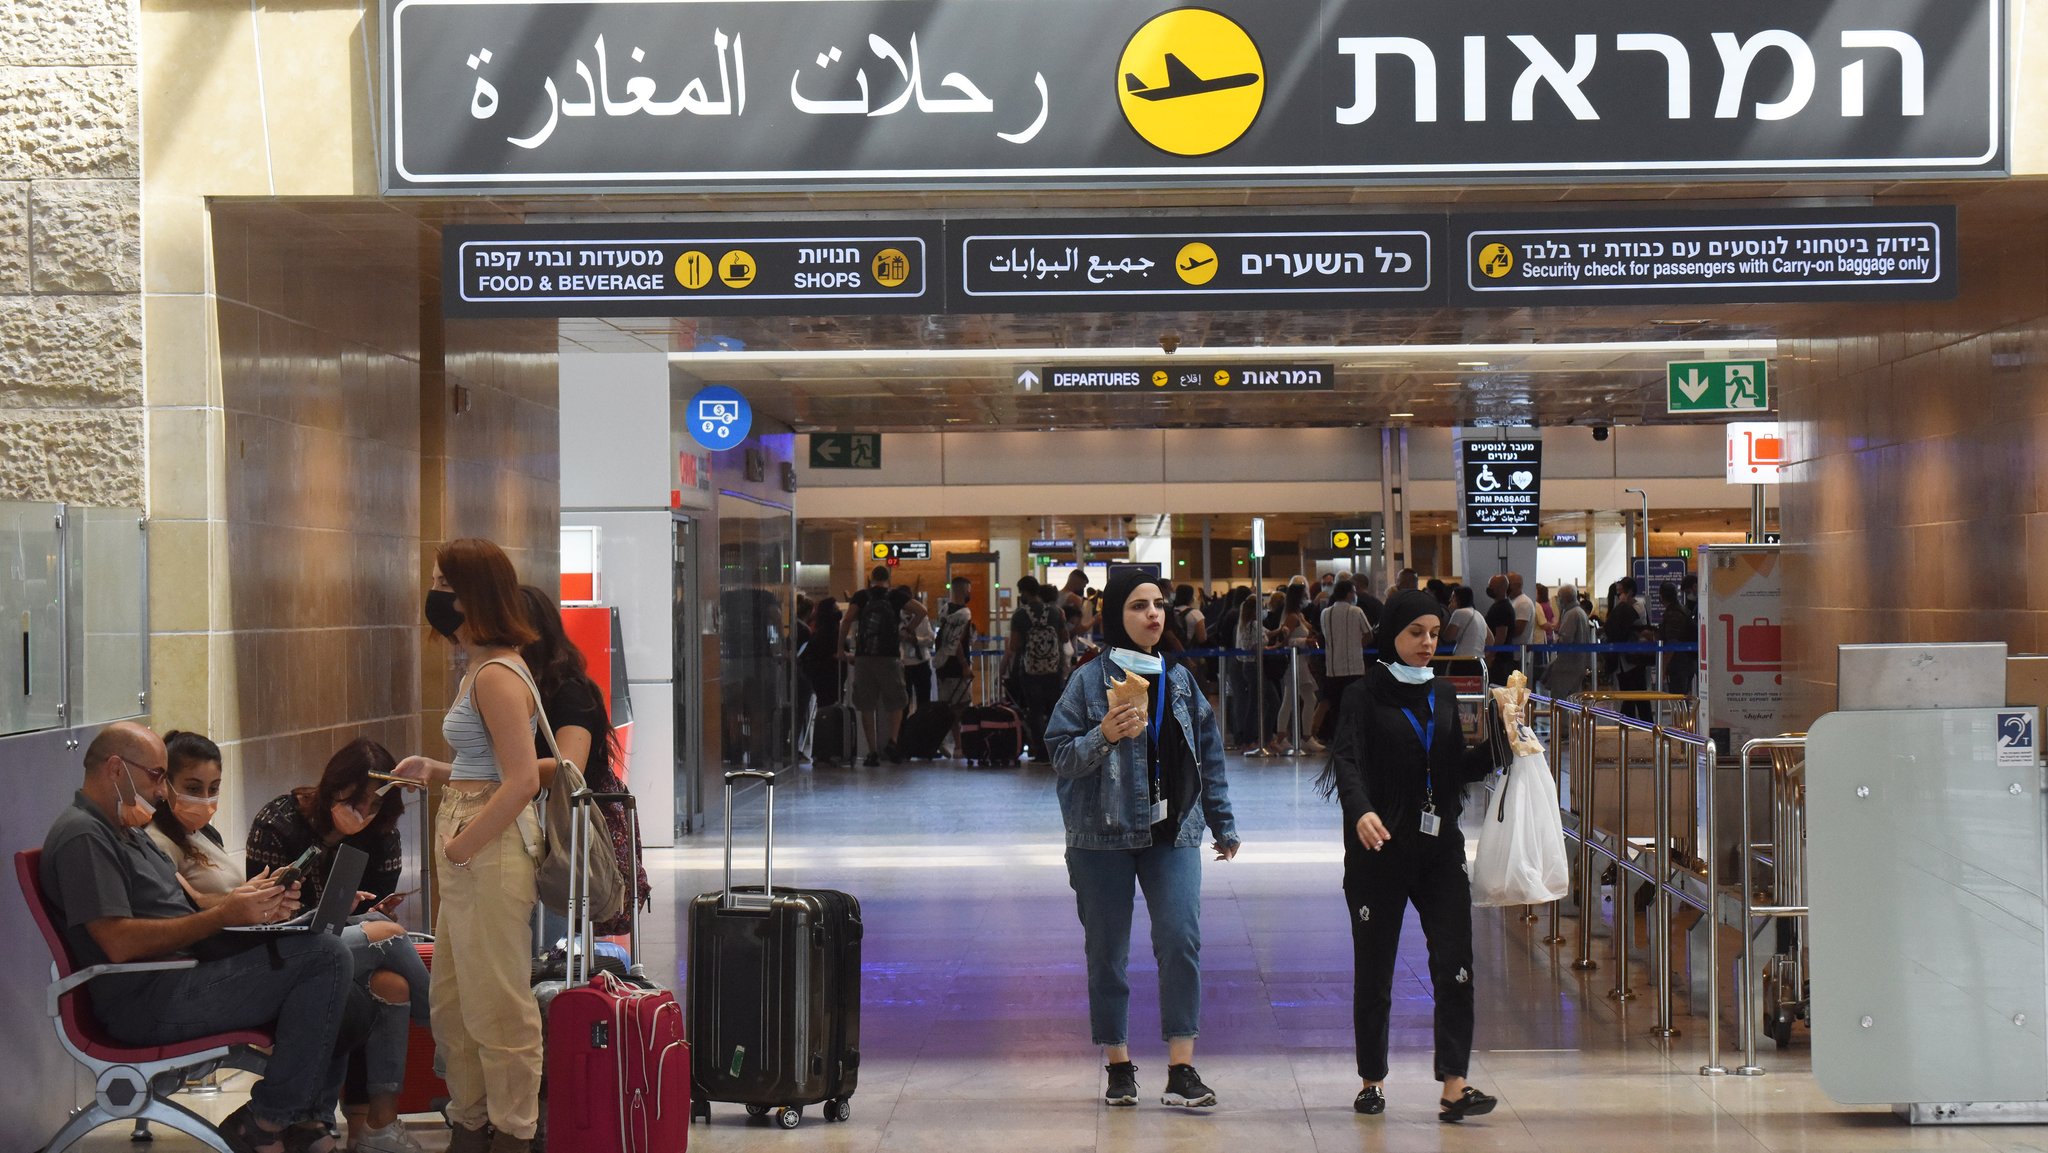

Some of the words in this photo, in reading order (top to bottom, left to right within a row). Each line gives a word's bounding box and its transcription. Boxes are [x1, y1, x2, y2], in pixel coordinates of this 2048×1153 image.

[1336, 30, 1926, 125] המראות
[466, 27, 746, 150] المغادرة
[790, 29, 1049, 145] رحلات
[1521, 240, 1572, 259] בלבד
[1578, 243, 1596, 258] יד
[1604, 241, 1664, 258] כבודת
[1672, 241, 1701, 258] עם
[1708, 236, 1789, 258] לנוסעים
[1796, 238, 1869, 254] ביטחוני
[1876, 237, 1930, 256] בידוק
[475, 251, 522, 270] קפה
[529, 250, 572, 268] ובתי
[579, 248, 664, 267] מסעדות
[798, 248, 860, 264] חנויות
[989, 246, 1079, 280] البوابات
[1241, 252, 1364, 278] השערים
[1375, 246, 1412, 273] כל
[1087, 258, 1156, 284] جميع
[1522, 261, 1581, 280] Security
[1584, 261, 1627, 277] check
[1629, 260, 1650, 276] for
[1653, 261, 1736, 279] passengers
[1739, 259, 1769, 274] with
[1772, 257, 1834, 276] Carry-on
[1838, 255, 1895, 276] baggage
[1898, 255, 1930, 274] only
[479, 275, 534, 292] FOOD
[539, 275, 553, 291] &
[558, 274, 665, 291] BEVERAGE
[794, 272, 861, 289] SHOPS
[1054, 372, 1140, 387] DEPARTURES
[1242, 370, 1322, 385] המראות
[1471, 442, 1507, 452] לנוסעים
[1510, 443, 1535, 452] מעבר
[1487, 452, 1518, 461] נעזרים
[1474, 495, 1493, 503] PRM
[1494, 495, 1531, 503] PASSAGE
[887, 558, 898, 566] 07
[2022, 737, 2029, 745] T
